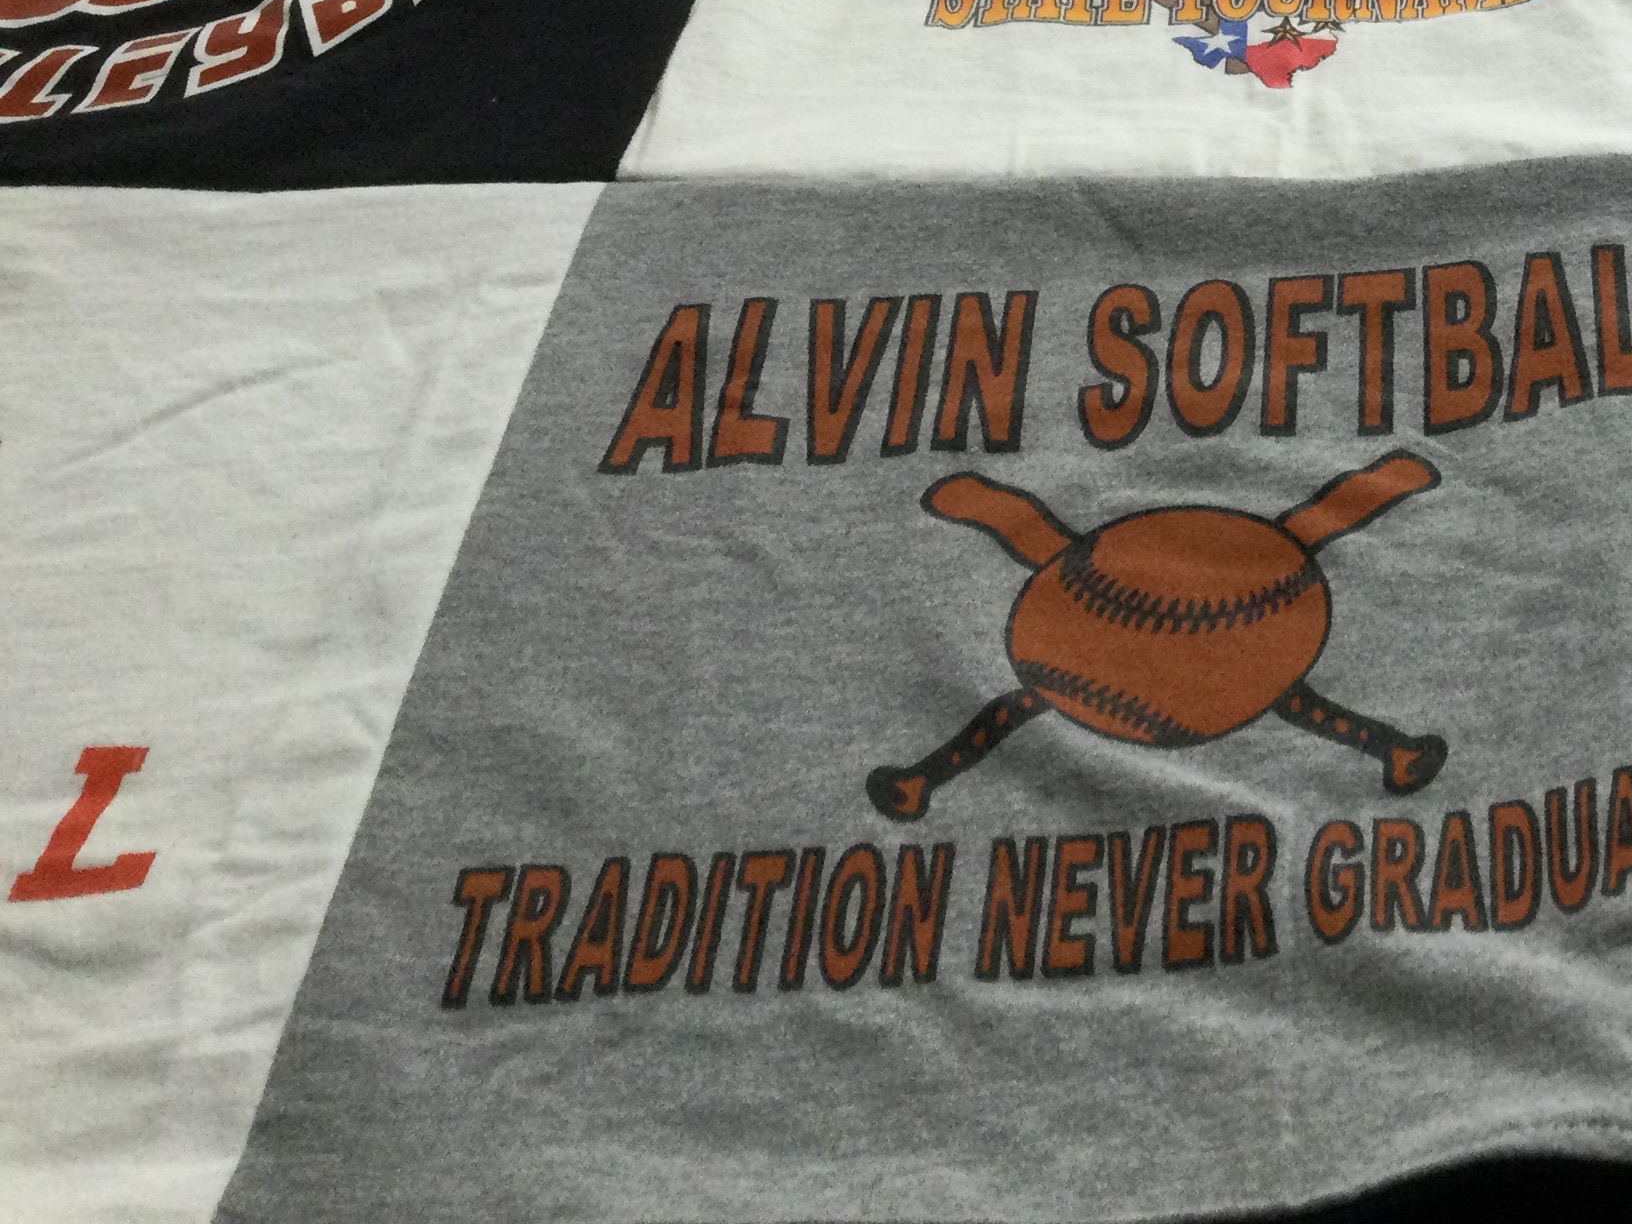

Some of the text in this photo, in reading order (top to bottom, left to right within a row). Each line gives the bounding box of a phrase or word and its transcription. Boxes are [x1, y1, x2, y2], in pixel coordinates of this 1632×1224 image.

[600, 288, 1040, 476] ALVIN
[442, 841, 954, 1010] TRADITION
[976, 812, 1279, 983] NEVER
